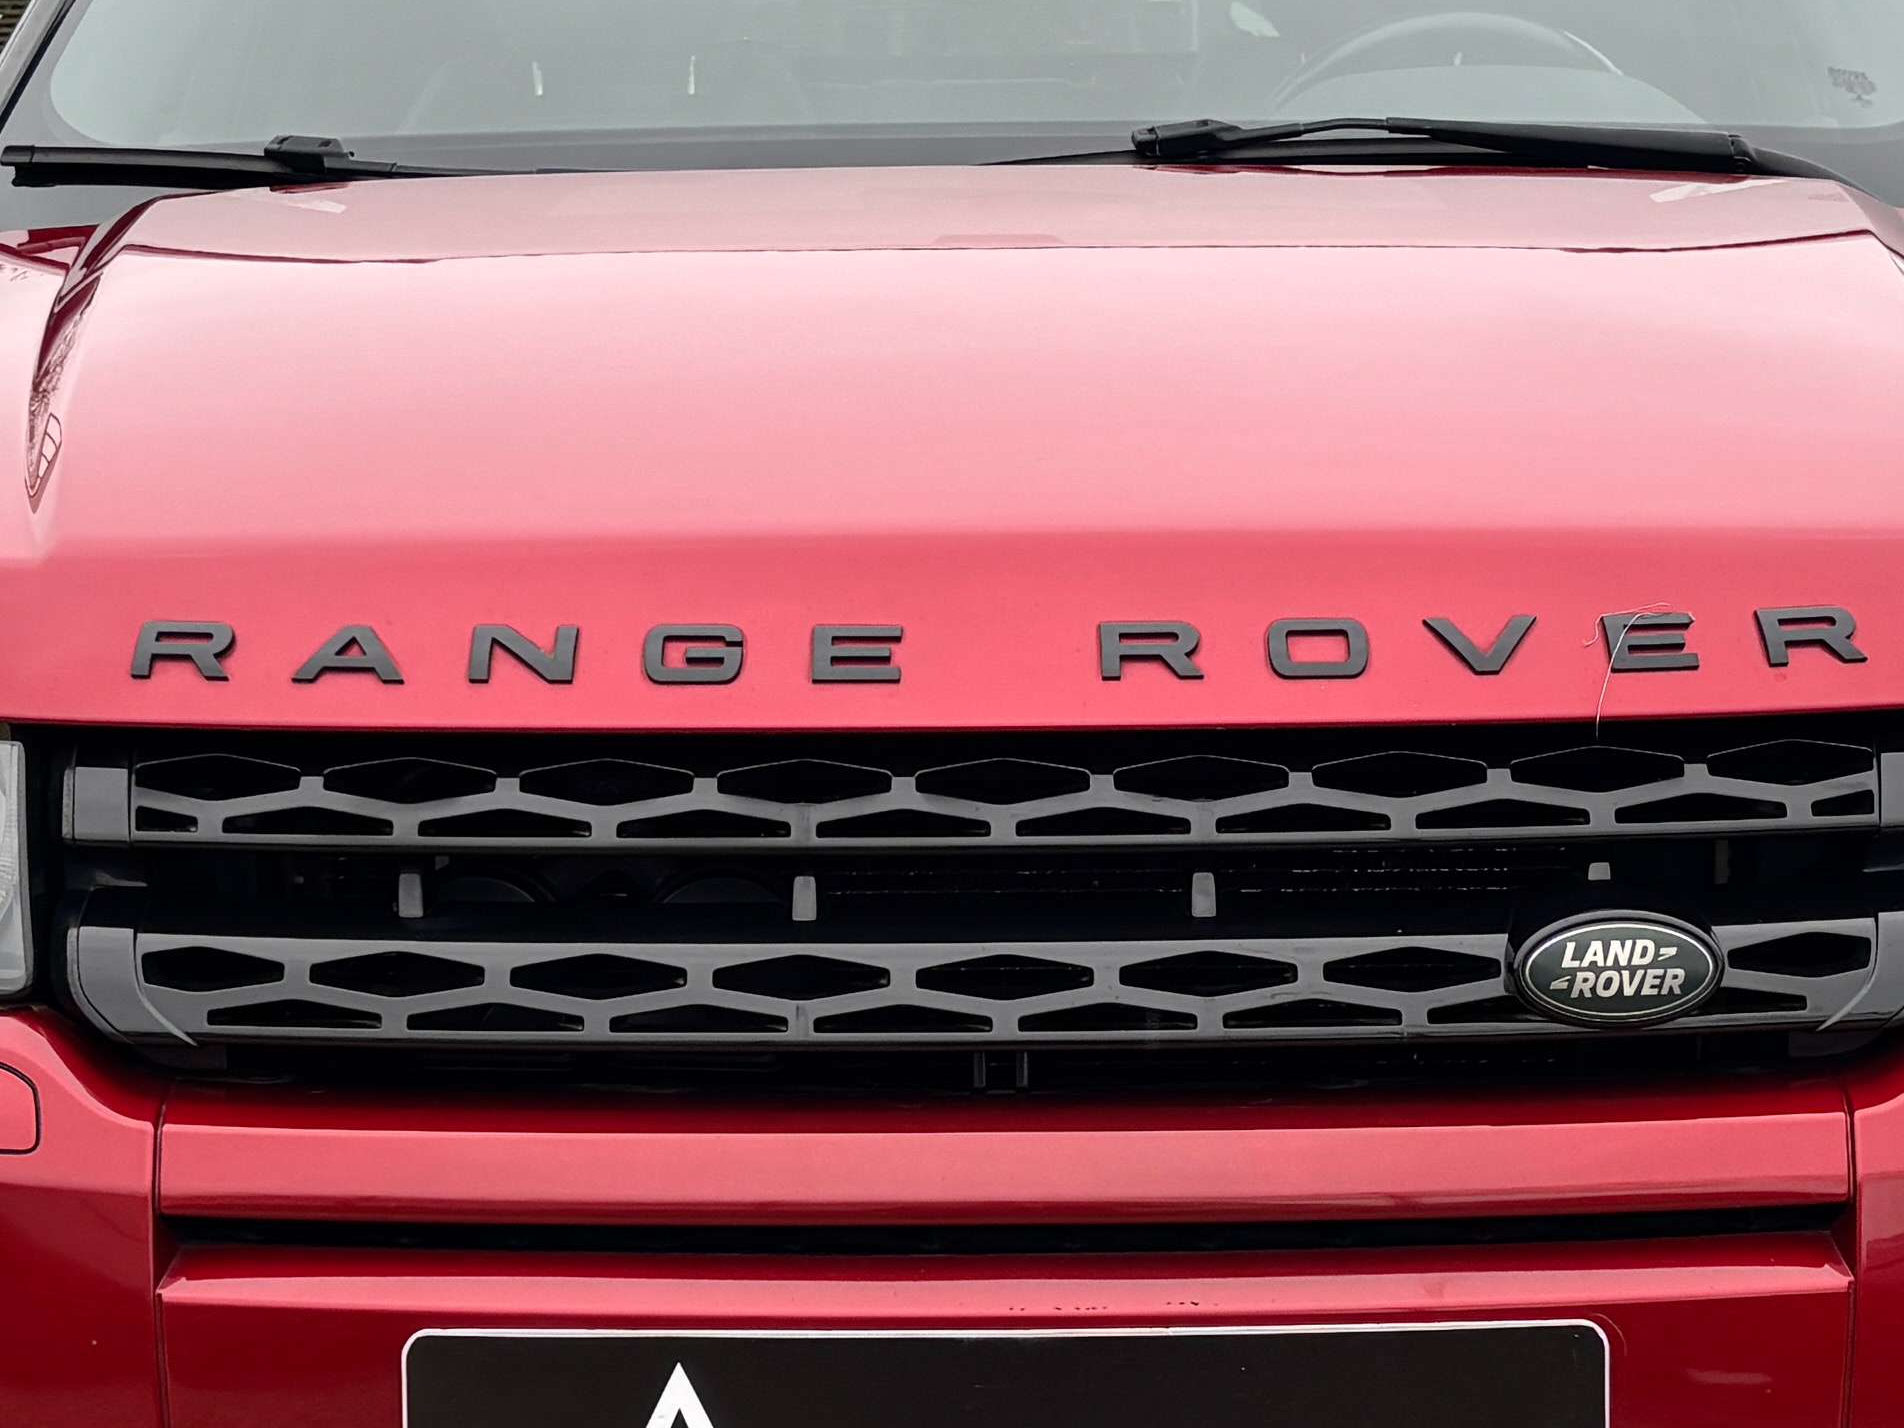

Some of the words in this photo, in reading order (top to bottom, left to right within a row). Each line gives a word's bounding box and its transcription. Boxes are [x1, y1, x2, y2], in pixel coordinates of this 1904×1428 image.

[131, 620, 904, 685] RANGE
[1098, 605, 1869, 681] ROVER
[1561, 939, 1656, 968] LAND
[1570, 968, 1686, 999] ROVER
